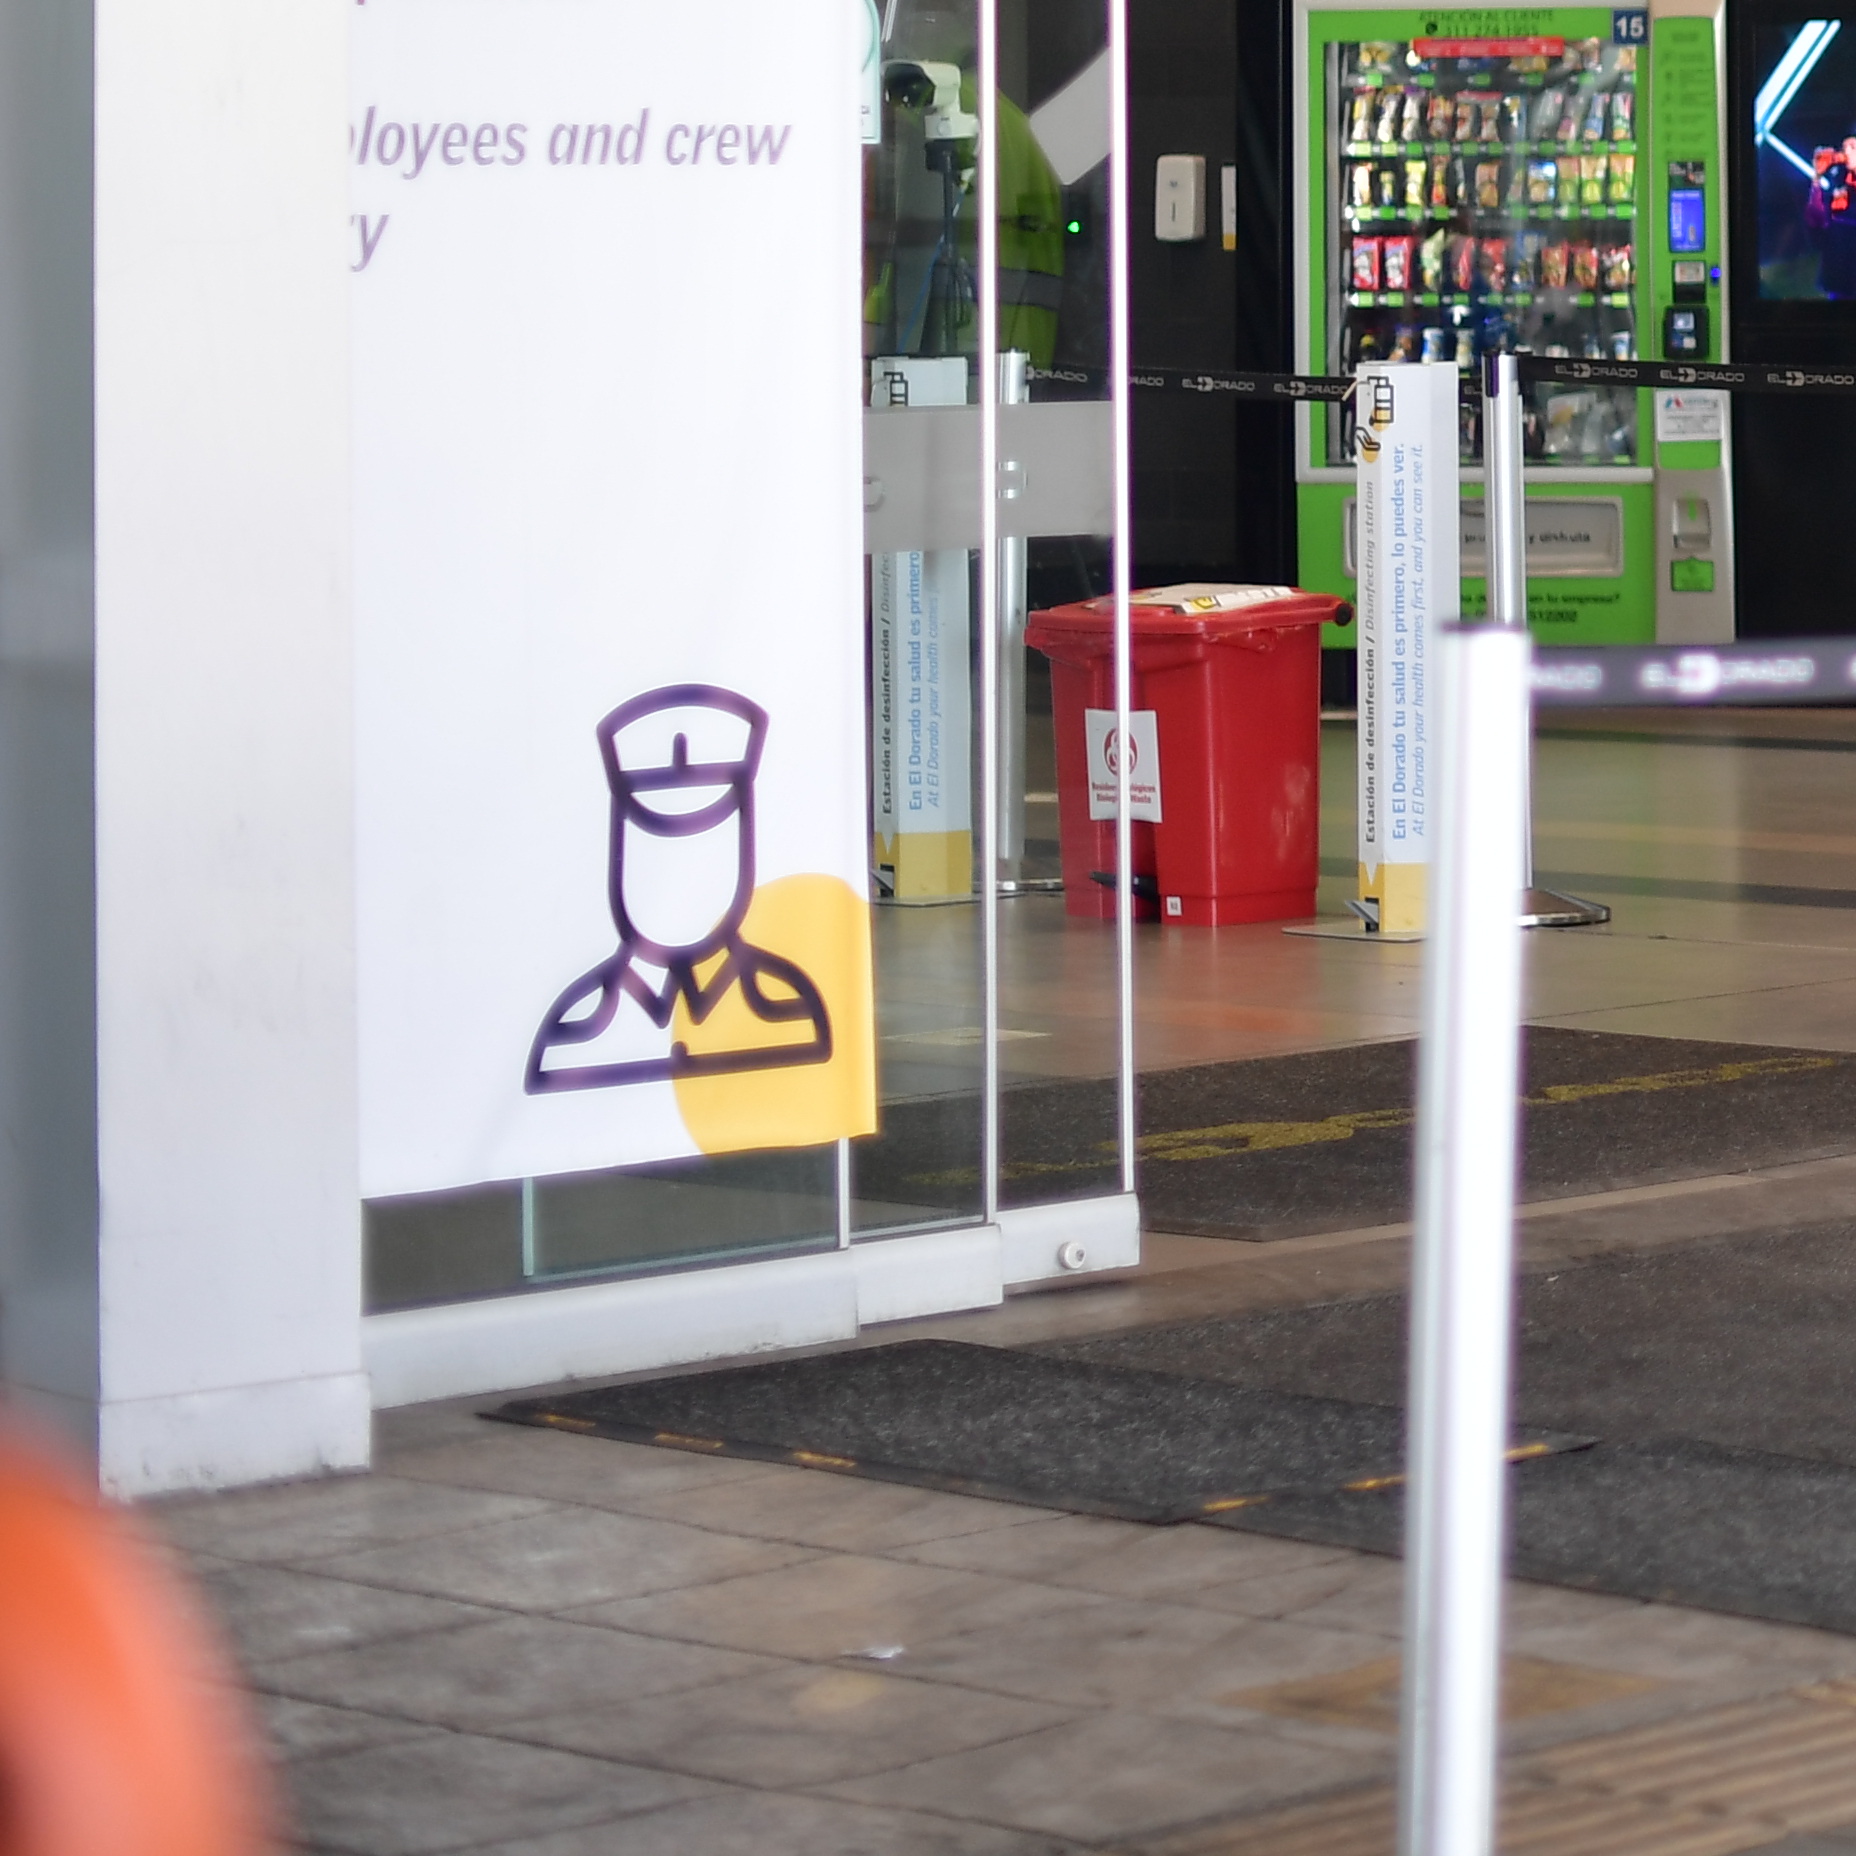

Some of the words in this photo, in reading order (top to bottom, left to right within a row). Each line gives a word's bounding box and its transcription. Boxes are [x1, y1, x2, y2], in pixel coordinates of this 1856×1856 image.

[1616, 17, 1644, 38] 15
[351, 106, 527, 180] loyees
[548, 108, 650, 166] and
[665, 122, 791, 167] crew
[1392, 444, 1406, 474] ver.
[1362, 482, 1374, 535] station
[1390, 480, 1408, 537] puedes
[1412, 489, 1424, 513] can
[1412, 519, 1426, 543] you
[1390, 543, 1406, 557] lo
[1411, 548, 1424, 572] and
[1362, 540, 1376, 630] Disinfecting
[1391, 563, 1409, 633] primero,
[910, 620, 921, 635] es
[1412, 616, 1425, 658] comes
[907, 641, 921, 682] salud
[1393, 639, 1406, 656] es
[908, 688, 921, 703] tu
[1364, 648, 1376, 747] desinfección
[1390, 662, 1407, 705] salud
[1411, 663, 1425, 707] health
[1391, 710, 1407, 728] tu
[1412, 712, 1426, 742] your
[908, 710, 922, 765] Dorado
[1364, 752, 1375, 770] de
[1391, 734, 1407, 793] Dorado
[1411, 747, 1426, 798] Dorado
[909, 791, 922, 809] En
[1364, 776, 1376, 843] Estación
[1391, 799, 1407, 813] El
[1411, 802, 1425, 814] El
[1391, 819, 1407, 839] En
[1411, 819, 1425, 835] At
